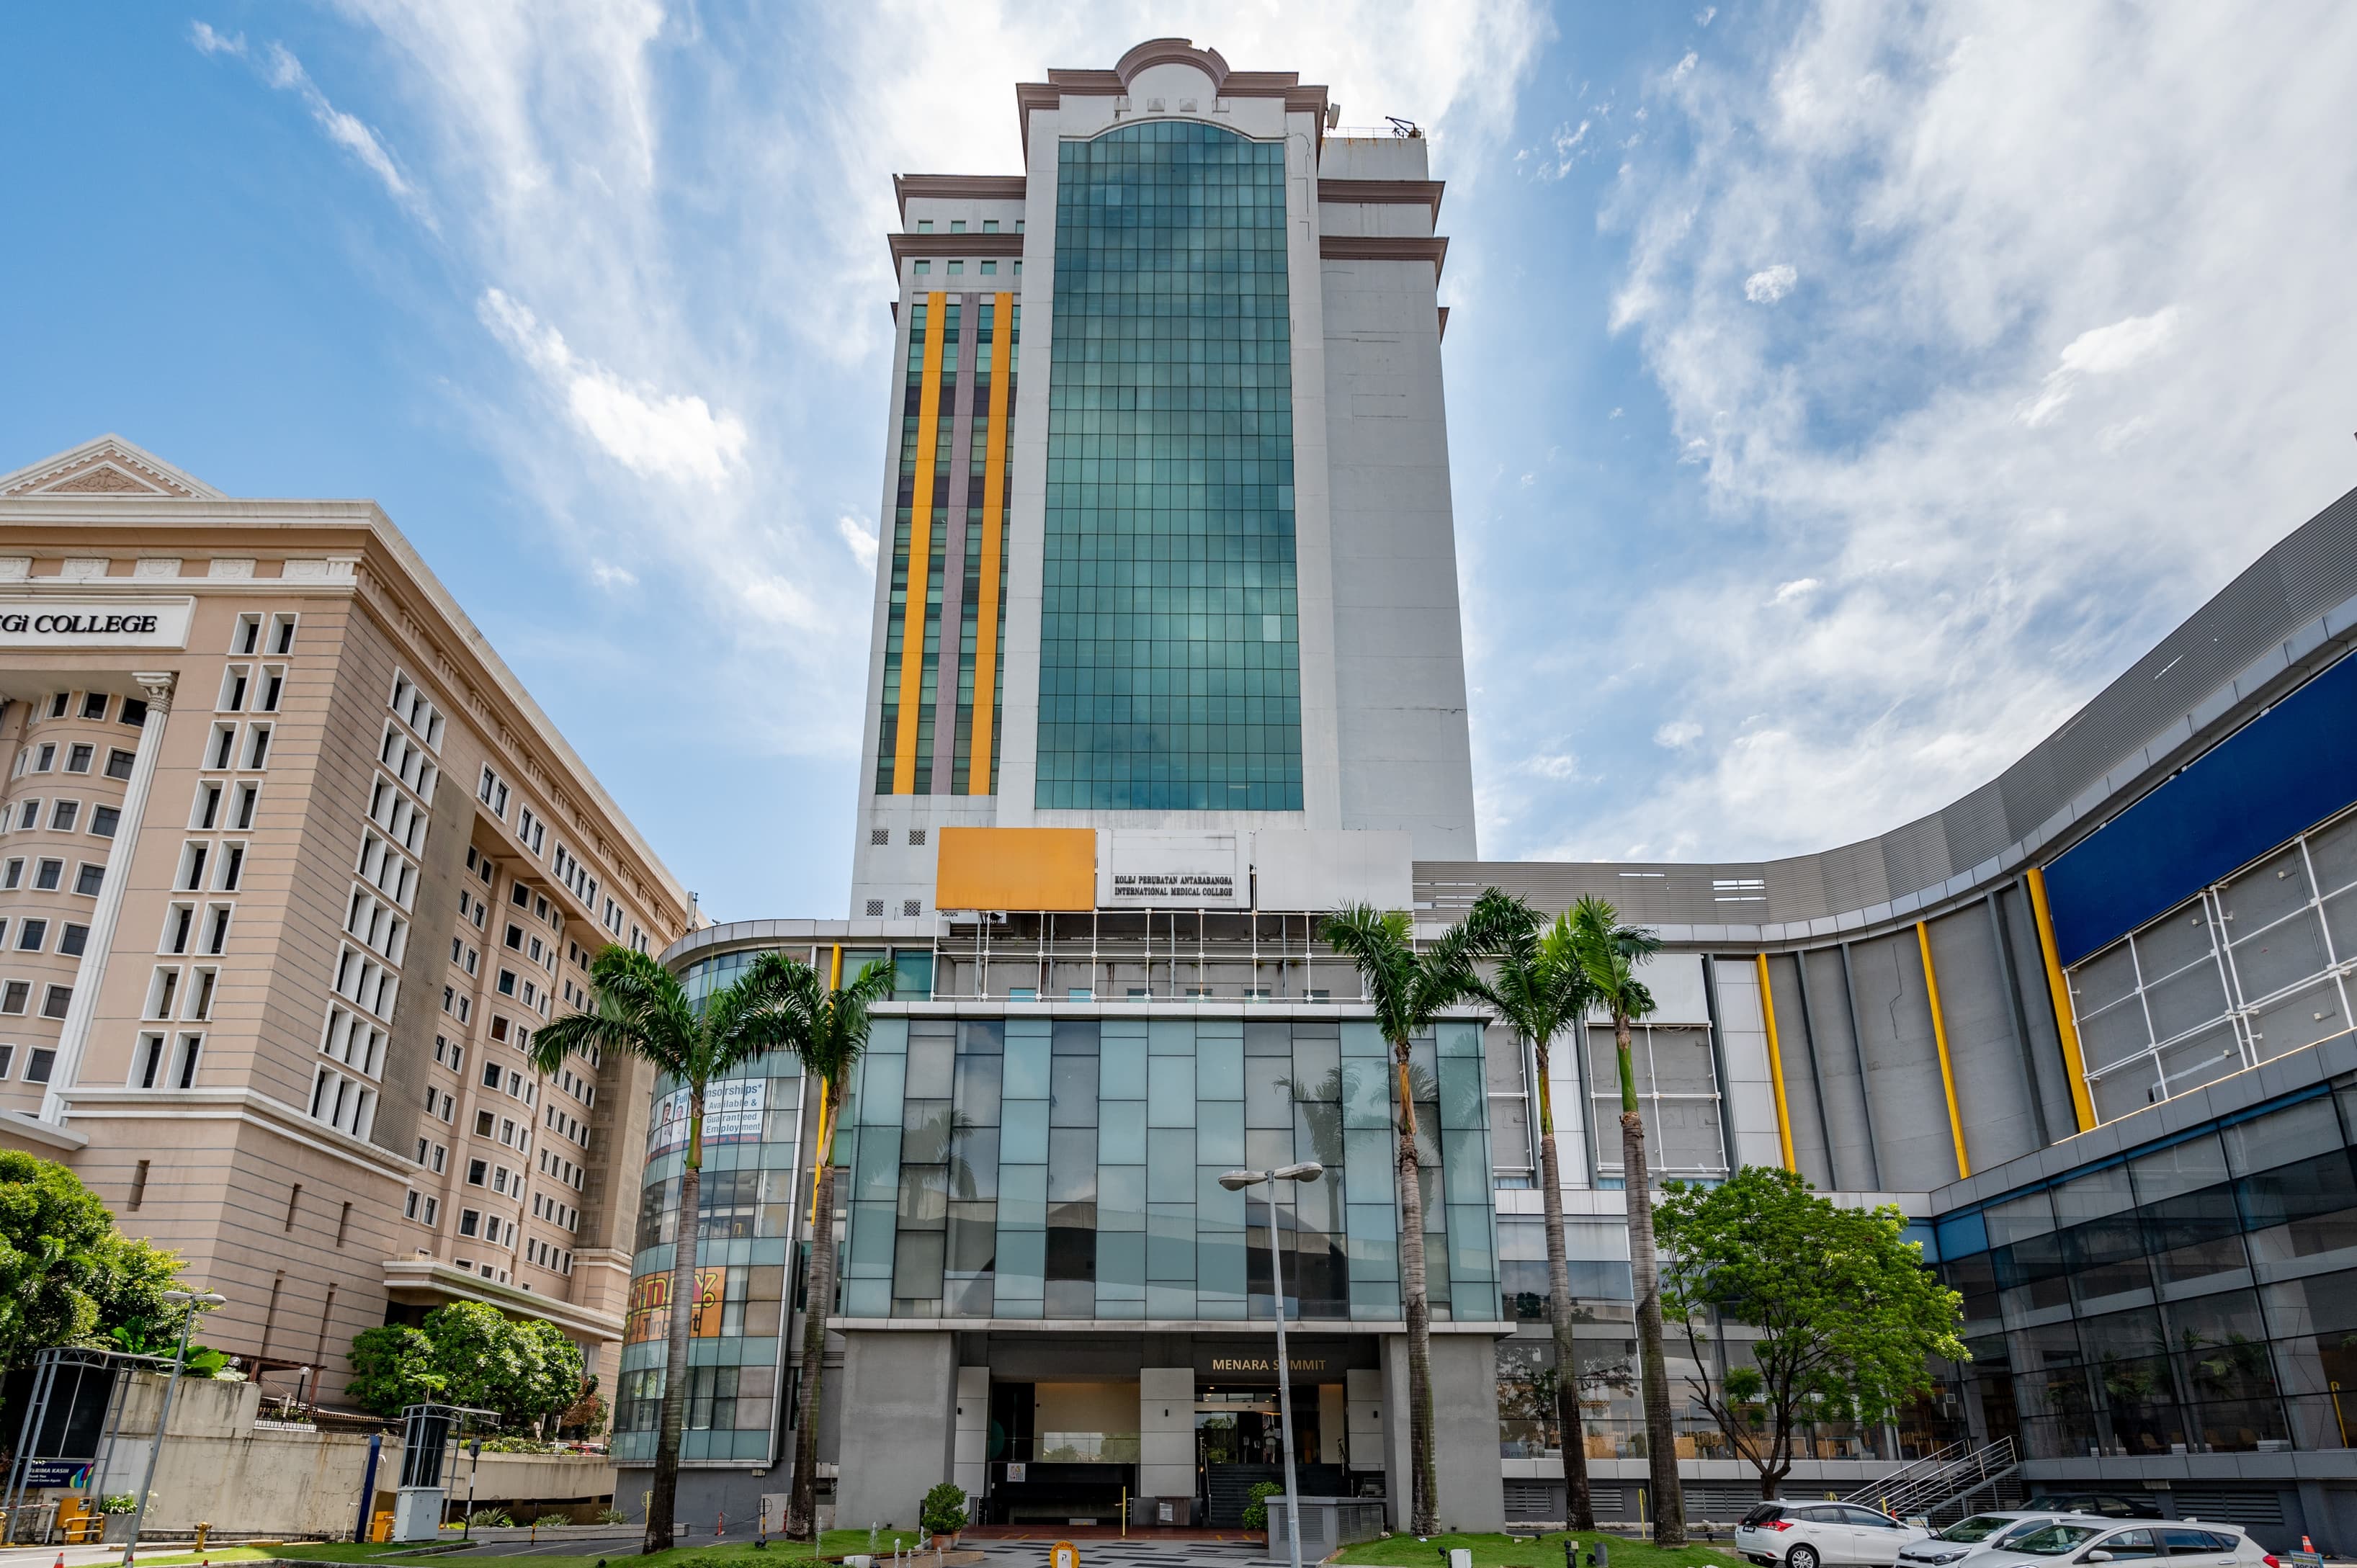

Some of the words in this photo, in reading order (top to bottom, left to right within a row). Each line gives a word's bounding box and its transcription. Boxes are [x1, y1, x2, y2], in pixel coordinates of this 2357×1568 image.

[0, 614, 30, 632] Gi
[35, 615, 157, 633] COLLEGE
[1138, 876, 1178, 884] PERUBATAN
[1180, 877, 1233, 885] ANTARABANGSA
[1171, 887, 1201, 896] MEDICAL
[676, 1094, 688, 1105] Full
[709, 1099, 748, 1109] Available
[707, 1112, 757, 1123] Guaranteed
[706, 1123, 761, 1133] Employment
[1212, 1359, 1269, 1371] MENARA
[1273, 1359, 1326, 1371] SMMIT
